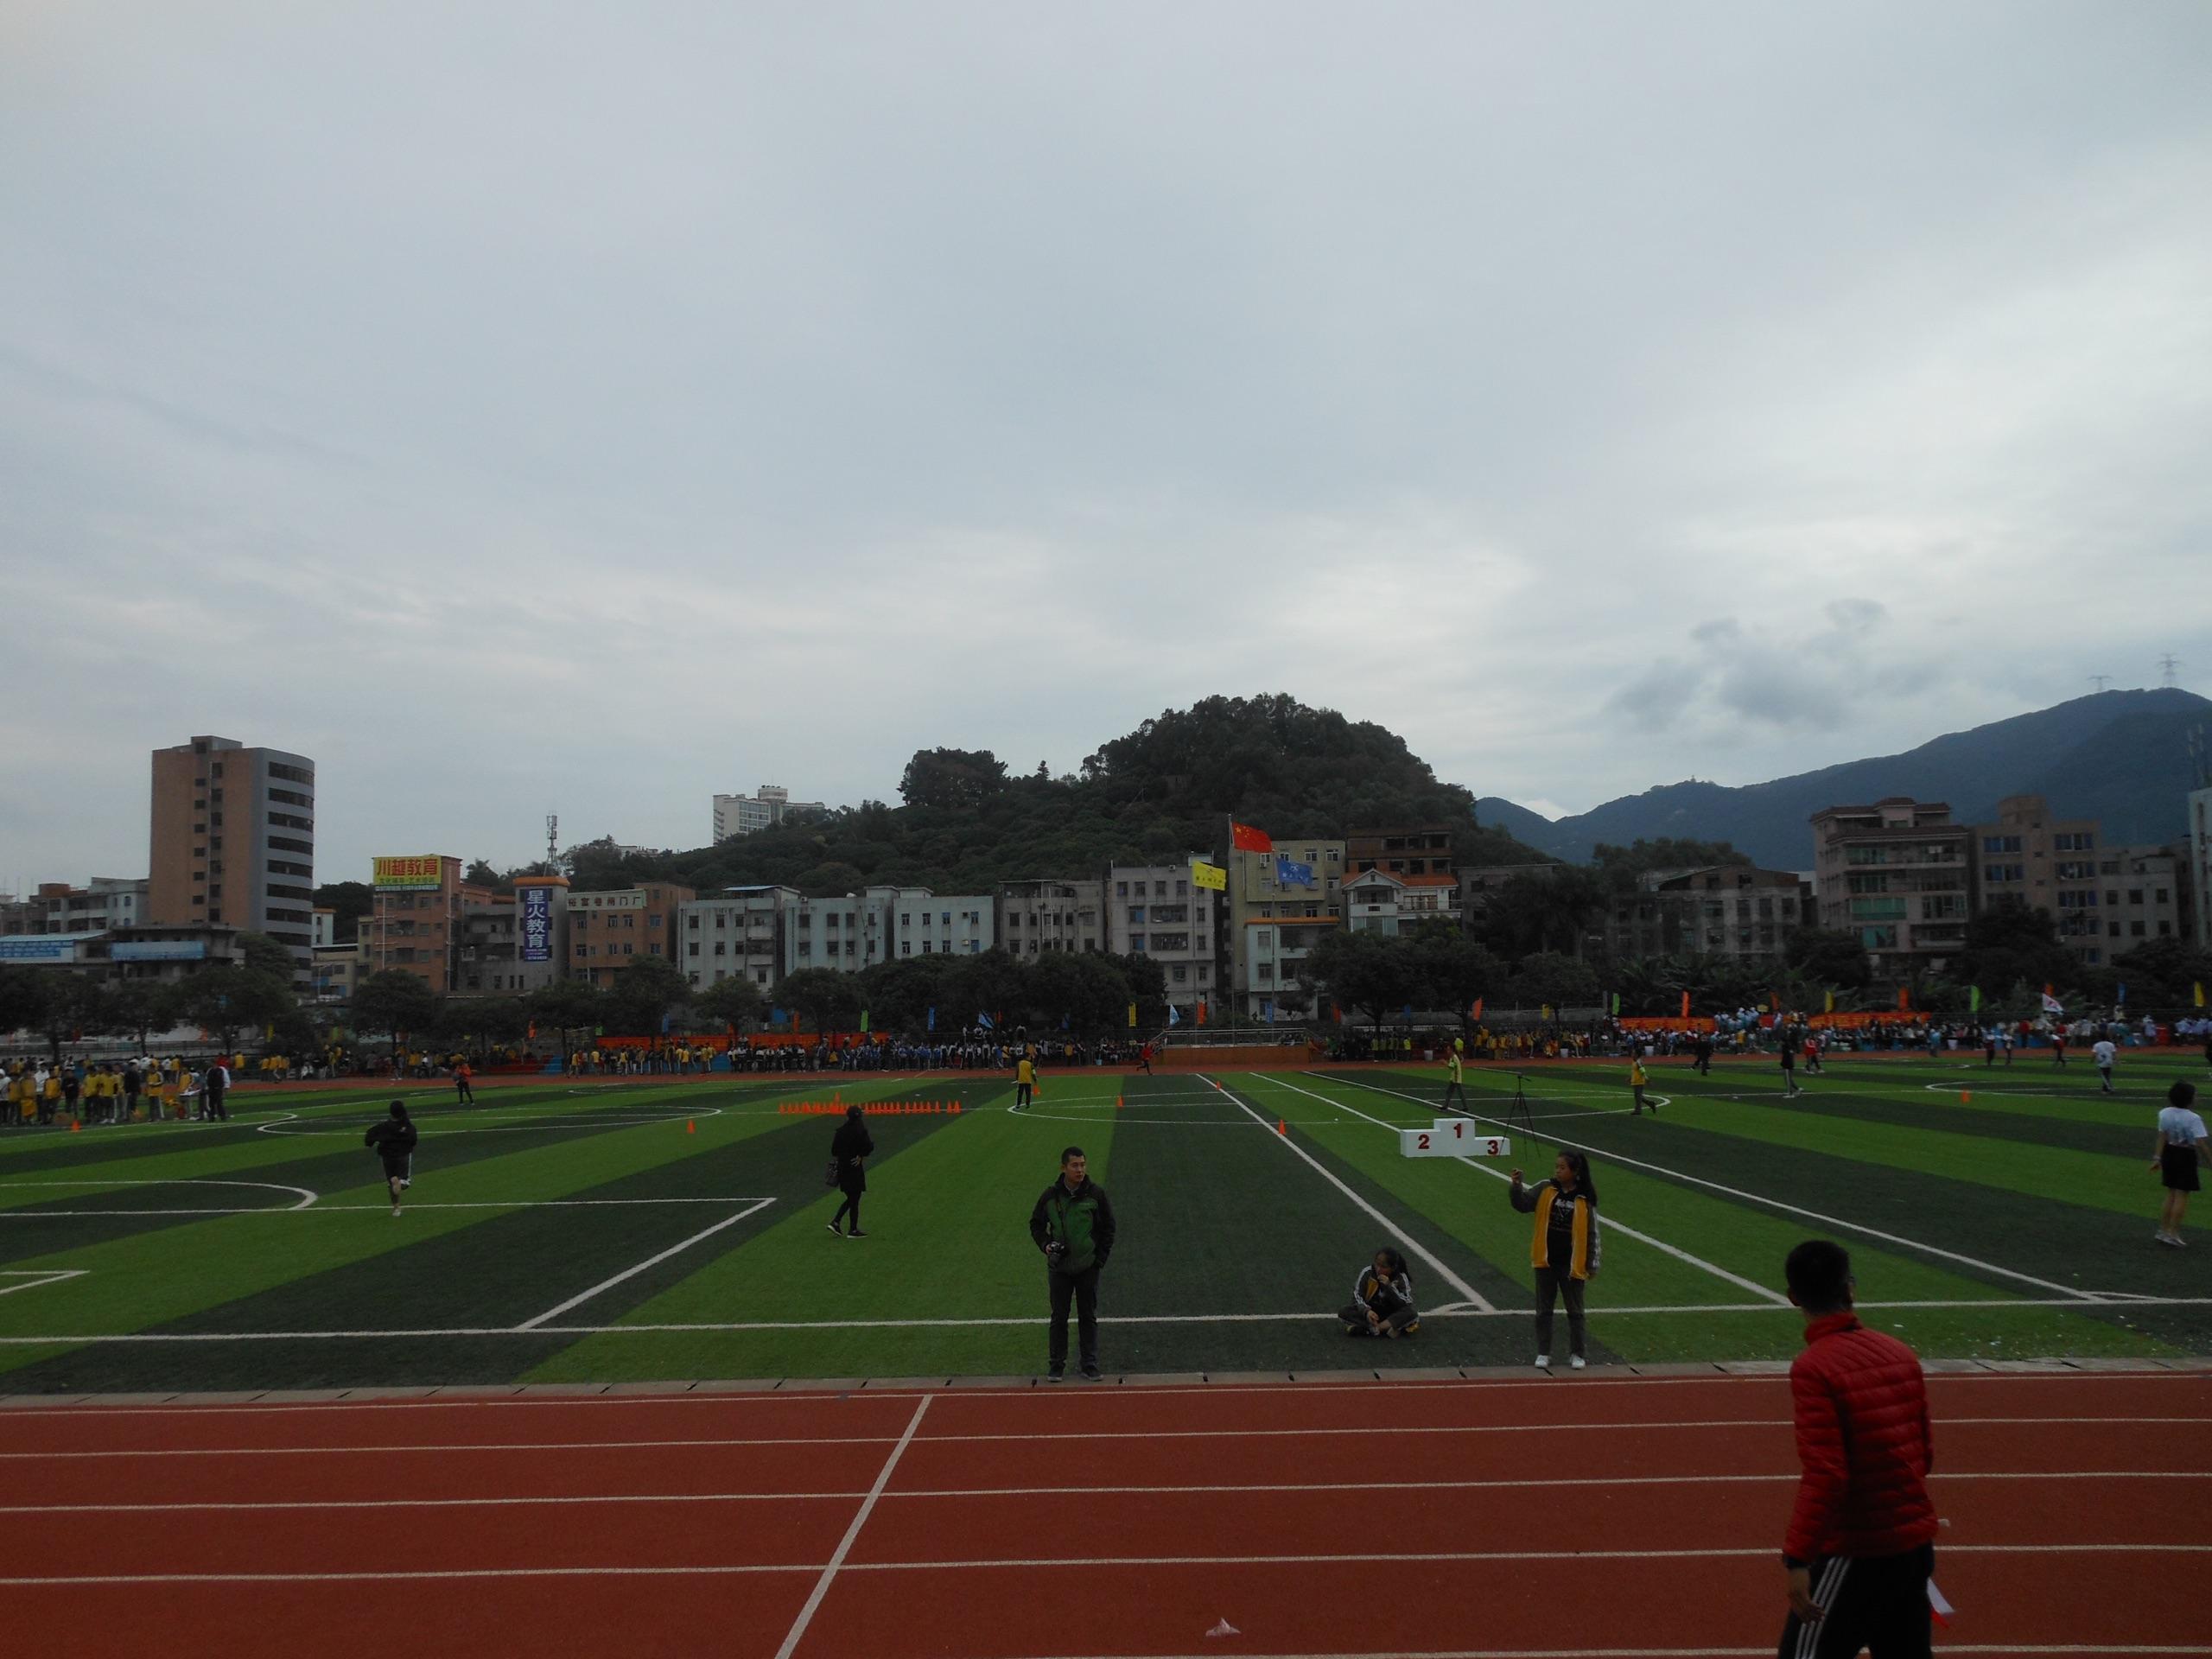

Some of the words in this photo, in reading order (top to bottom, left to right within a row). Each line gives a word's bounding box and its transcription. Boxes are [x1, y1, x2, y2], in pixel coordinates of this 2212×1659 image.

[377, 858, 437, 875] 川越教育
[526, 889, 546, 948] 星火教育
[1453, 1122, 1462, 1139] 1
[1418, 1134, 1430, 1149] 2
[1487, 1140, 1498, 1155] 3
